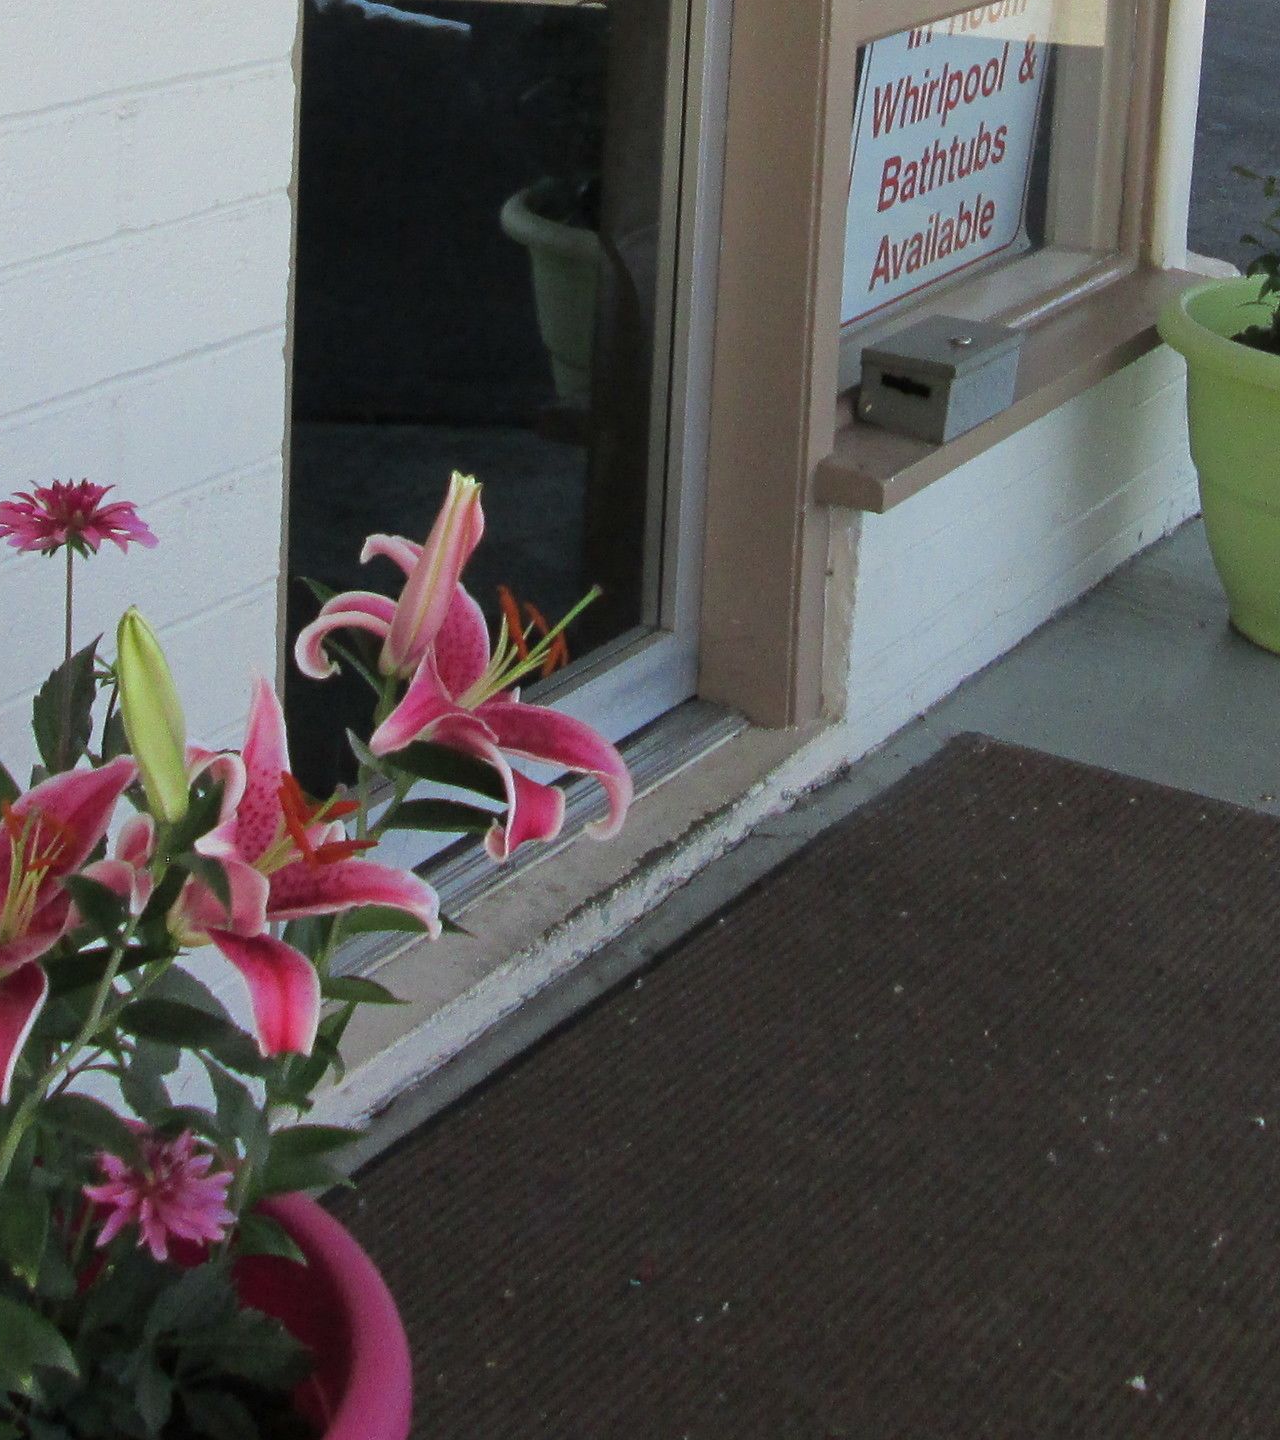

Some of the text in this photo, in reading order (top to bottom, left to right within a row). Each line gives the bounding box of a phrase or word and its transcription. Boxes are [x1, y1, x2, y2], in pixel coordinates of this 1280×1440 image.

[872, 33, 1038, 139] Whirlpool &
[876, 120, 1008, 214] Bathtubs
[867, 192, 996, 293] Available
